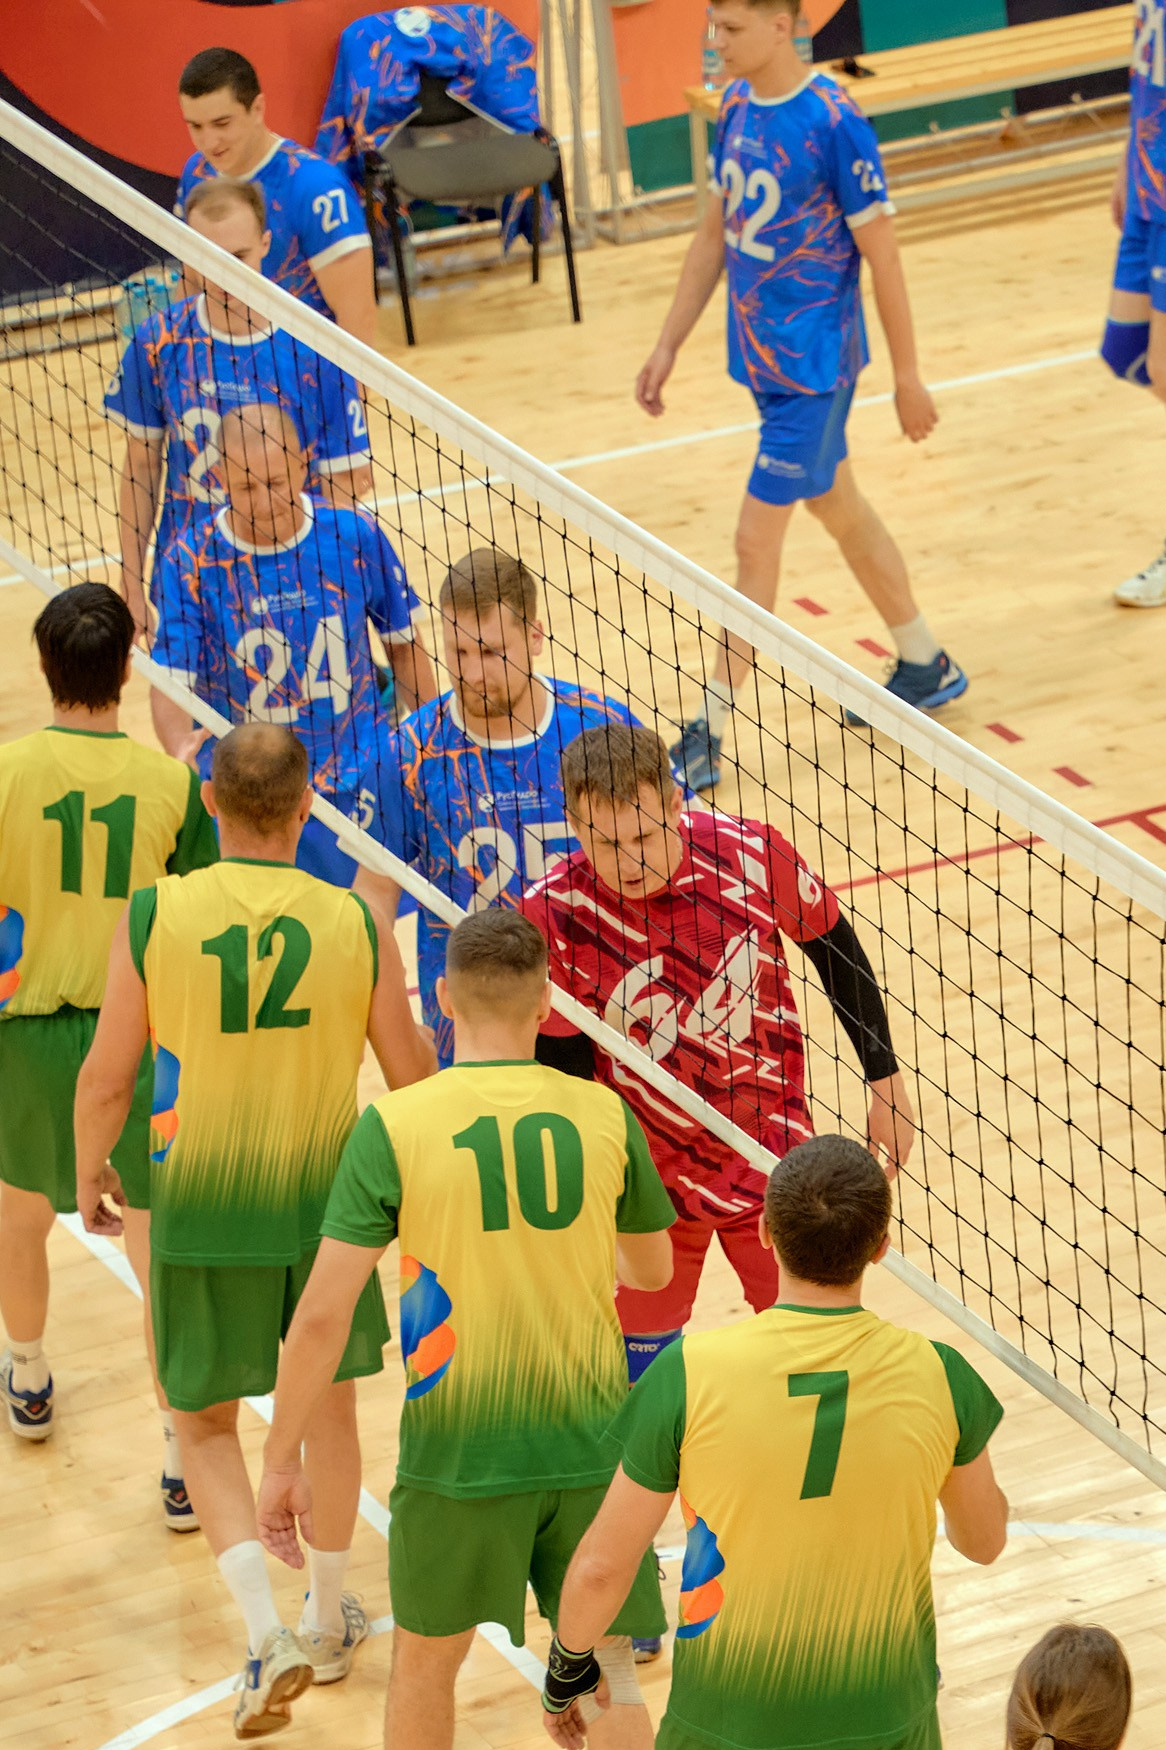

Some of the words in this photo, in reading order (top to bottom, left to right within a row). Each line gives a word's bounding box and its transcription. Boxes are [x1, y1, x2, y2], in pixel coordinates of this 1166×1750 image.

[312, 188, 349, 233] 27
[721, 159, 781, 262] 22
[235, 615, 352, 724] 24
[43, 790, 137, 900] 11
[201, 915, 312, 1034] 12
[605, 923, 763, 1063] 64
[452, 1112, 584, 1232] 10
[788, 1370, 848, 1500] 7
